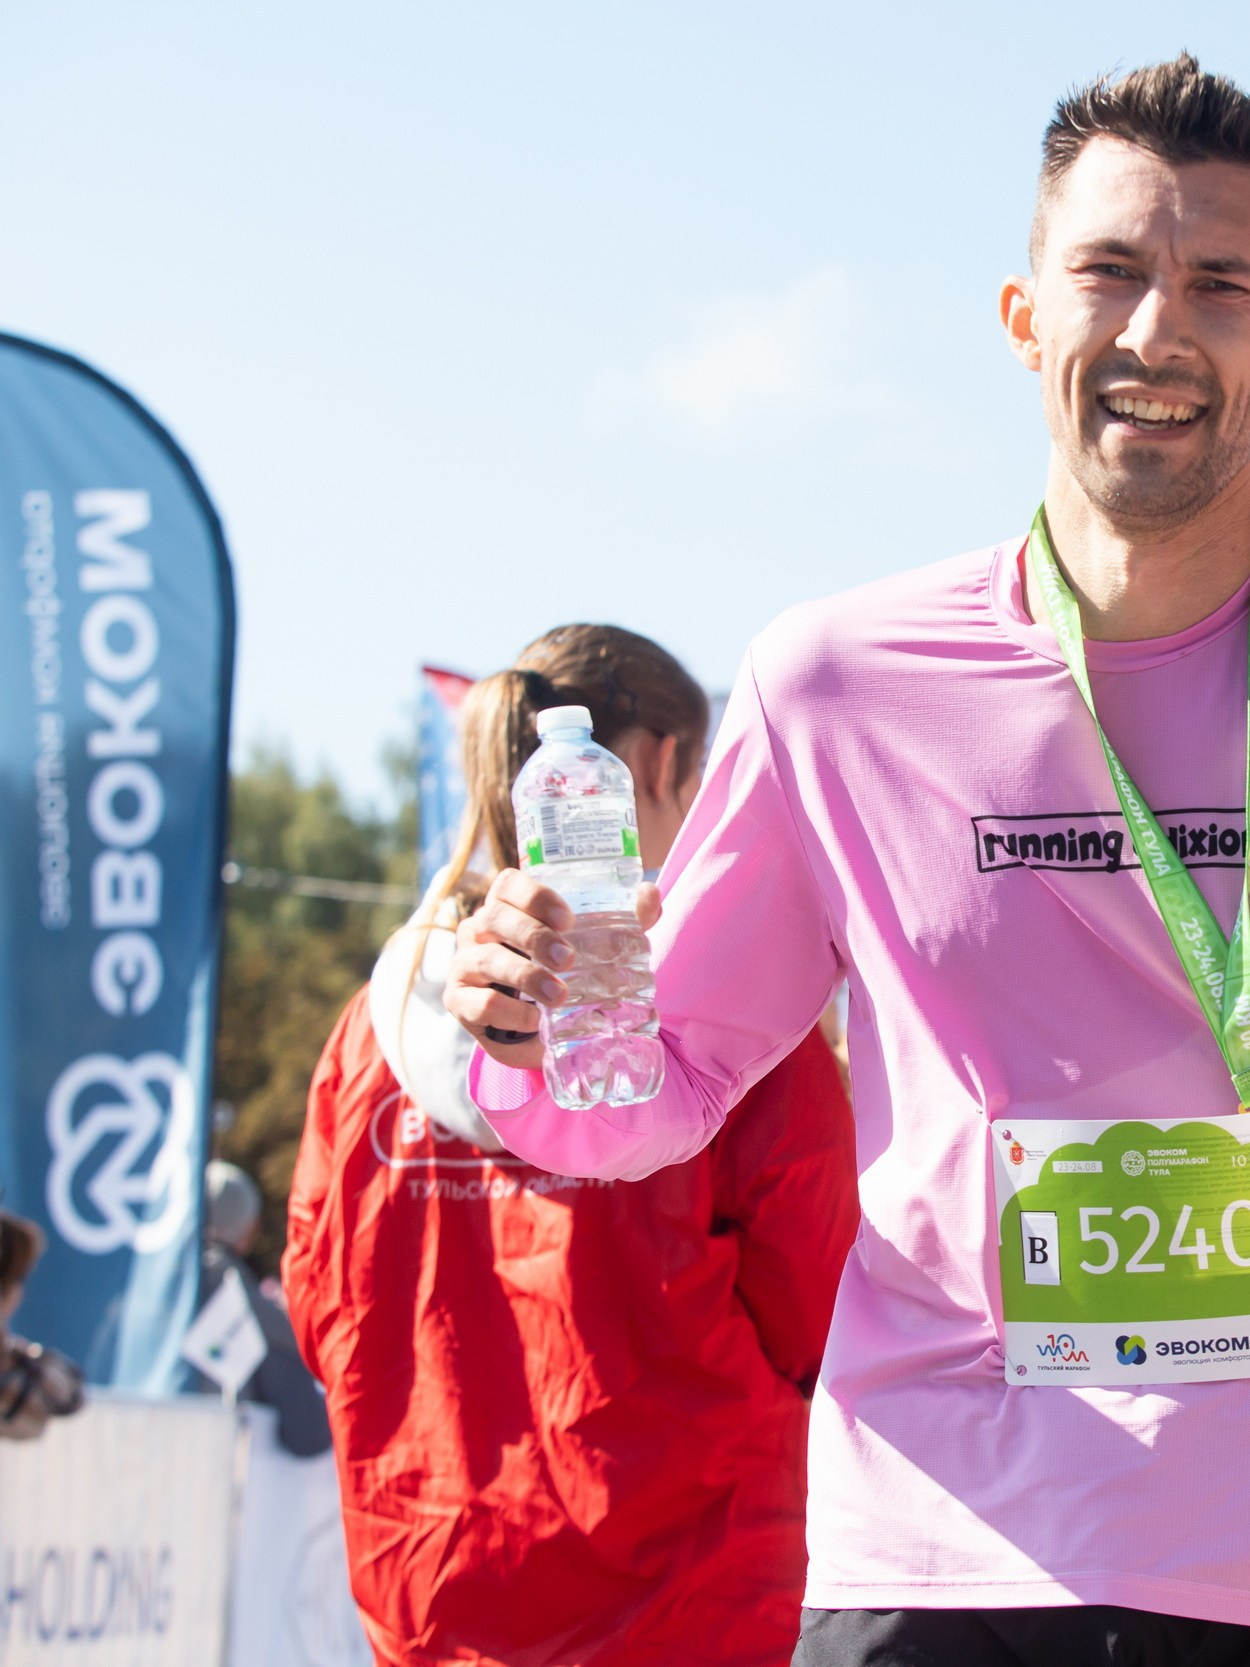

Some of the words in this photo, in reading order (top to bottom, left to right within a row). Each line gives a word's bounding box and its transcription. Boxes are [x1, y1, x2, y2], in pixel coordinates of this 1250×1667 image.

[983, 827, 1124, 874] running
[1141, 828, 1171, 877] ТУЛА
[1147, 1149, 1188, 1157] ЭВОКОМ
[1147, 1157, 1209, 1166] ПОЛУМАРАФОН
[1231, 1155, 1247, 1167] 10
[1058, 1162, 1098, 1172] 23-24.08
[1149, 1168, 1171, 1176] ТУЛА
[1155, 1336, 1250, 1356] ЭВОКОМ
[1173, 1357, 1211, 1366] эволюция
